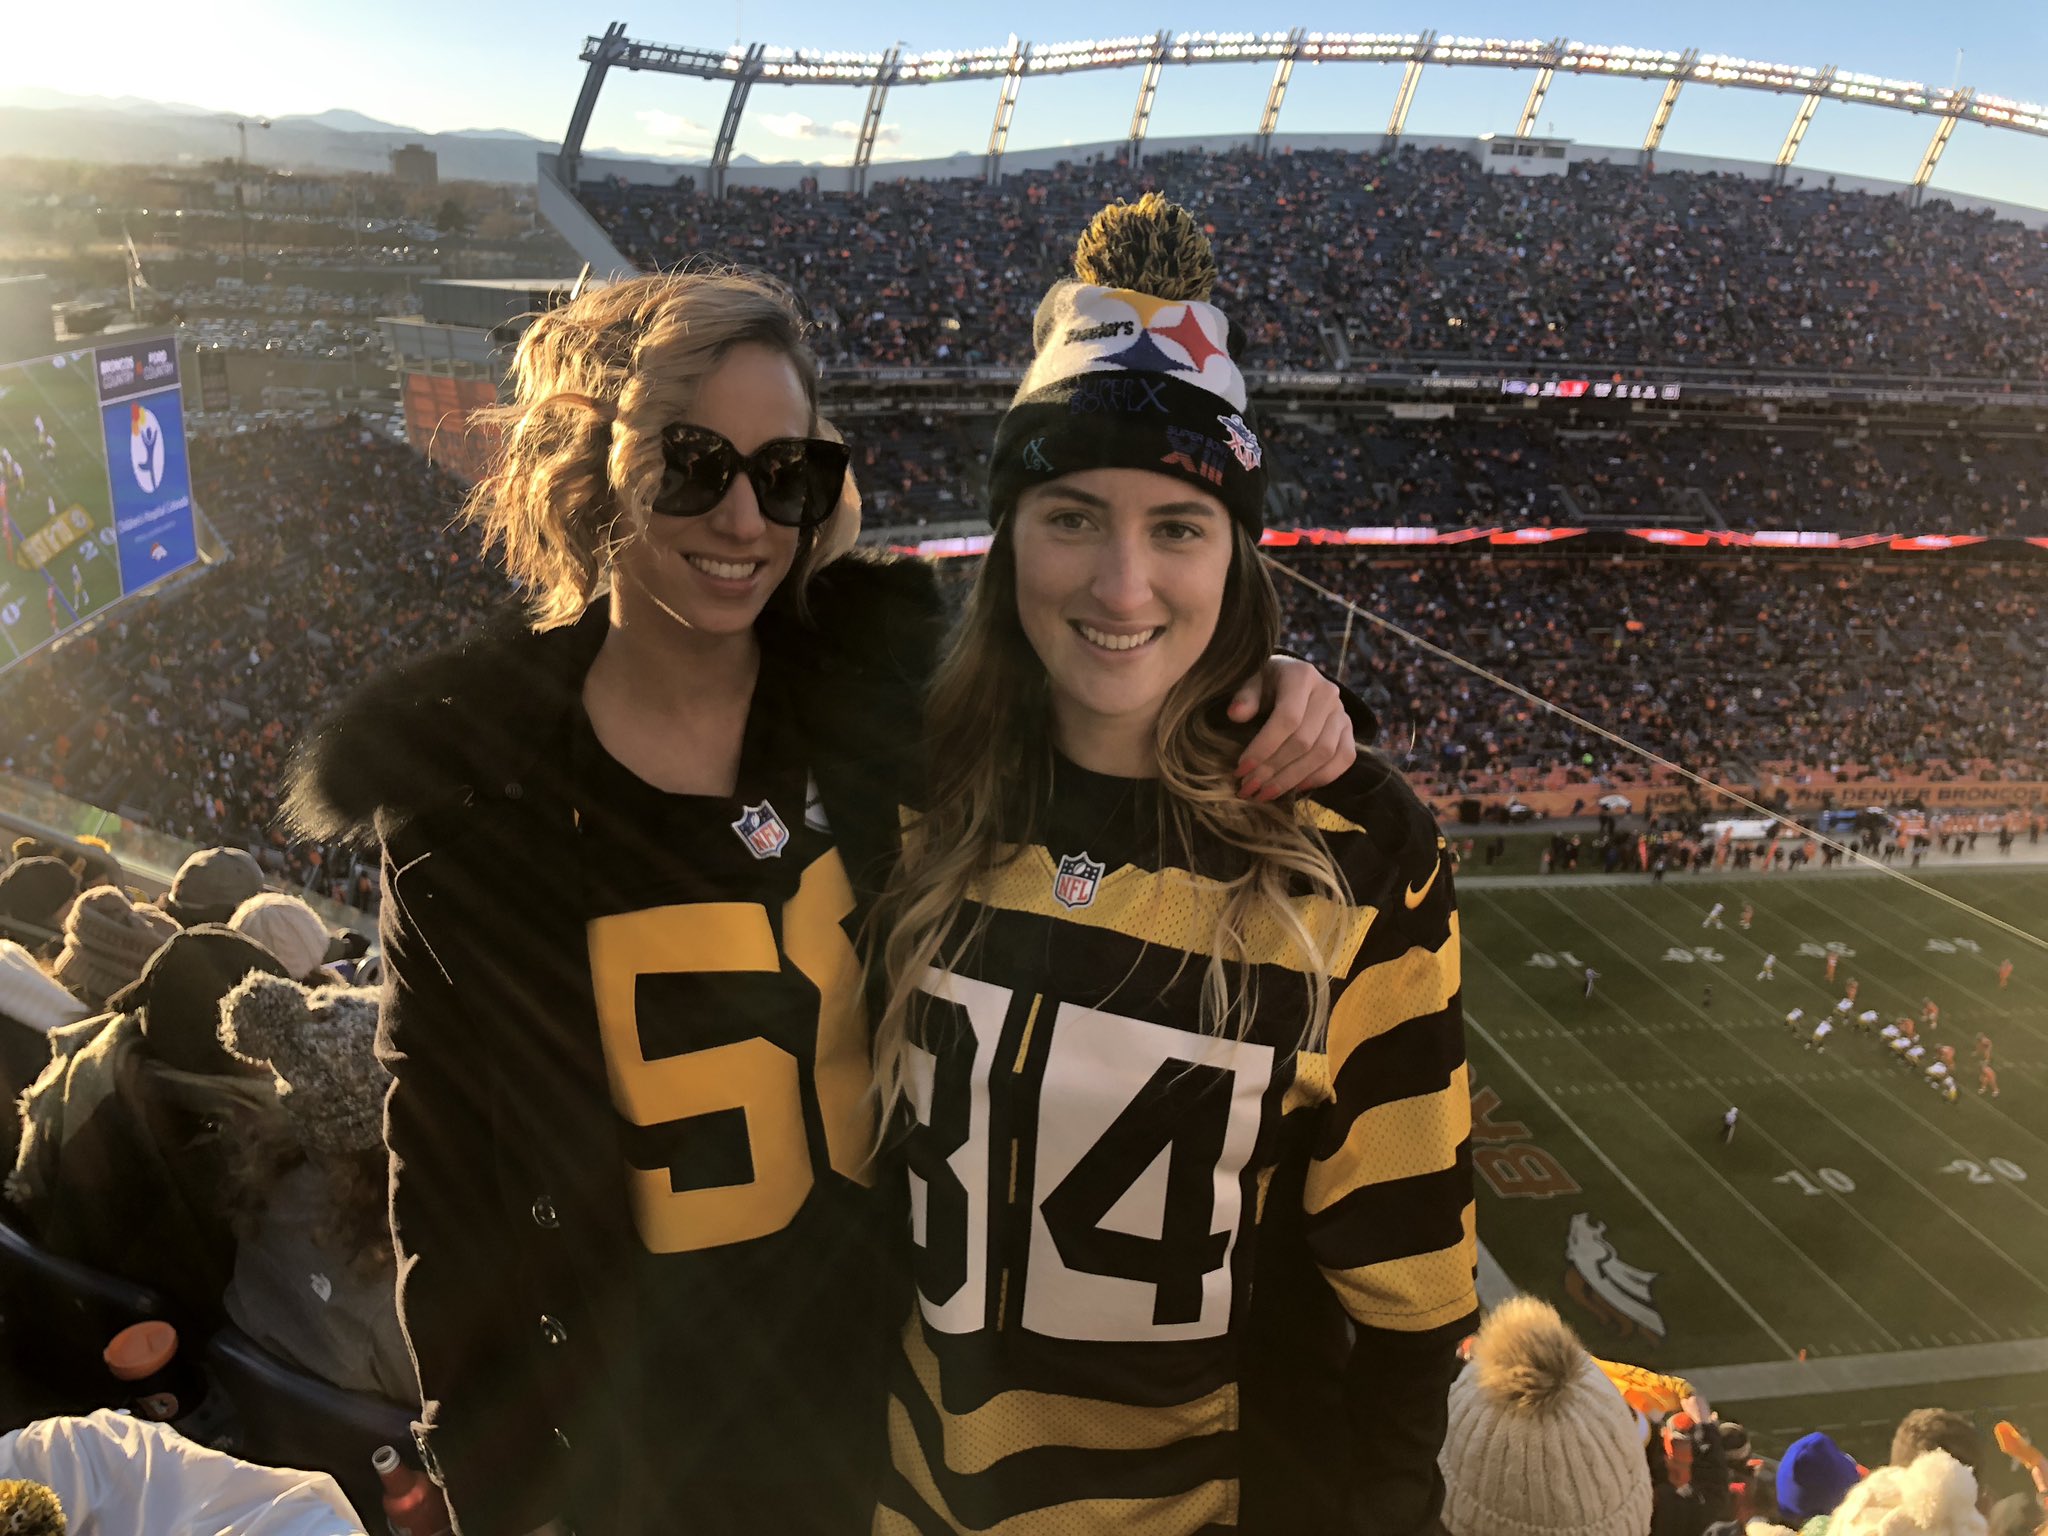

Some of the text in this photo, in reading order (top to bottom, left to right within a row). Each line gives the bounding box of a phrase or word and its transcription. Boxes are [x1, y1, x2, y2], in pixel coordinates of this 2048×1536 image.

[1842, 787, 1930, 801] DENVER
[1938, 787, 2042, 801] BRONCOS
[751, 822, 784, 851] NFL
[1057, 875, 1089, 901] NFL
[1785, 1167, 1856, 1196] 10
[1950, 1156, 2028, 1184] 20
